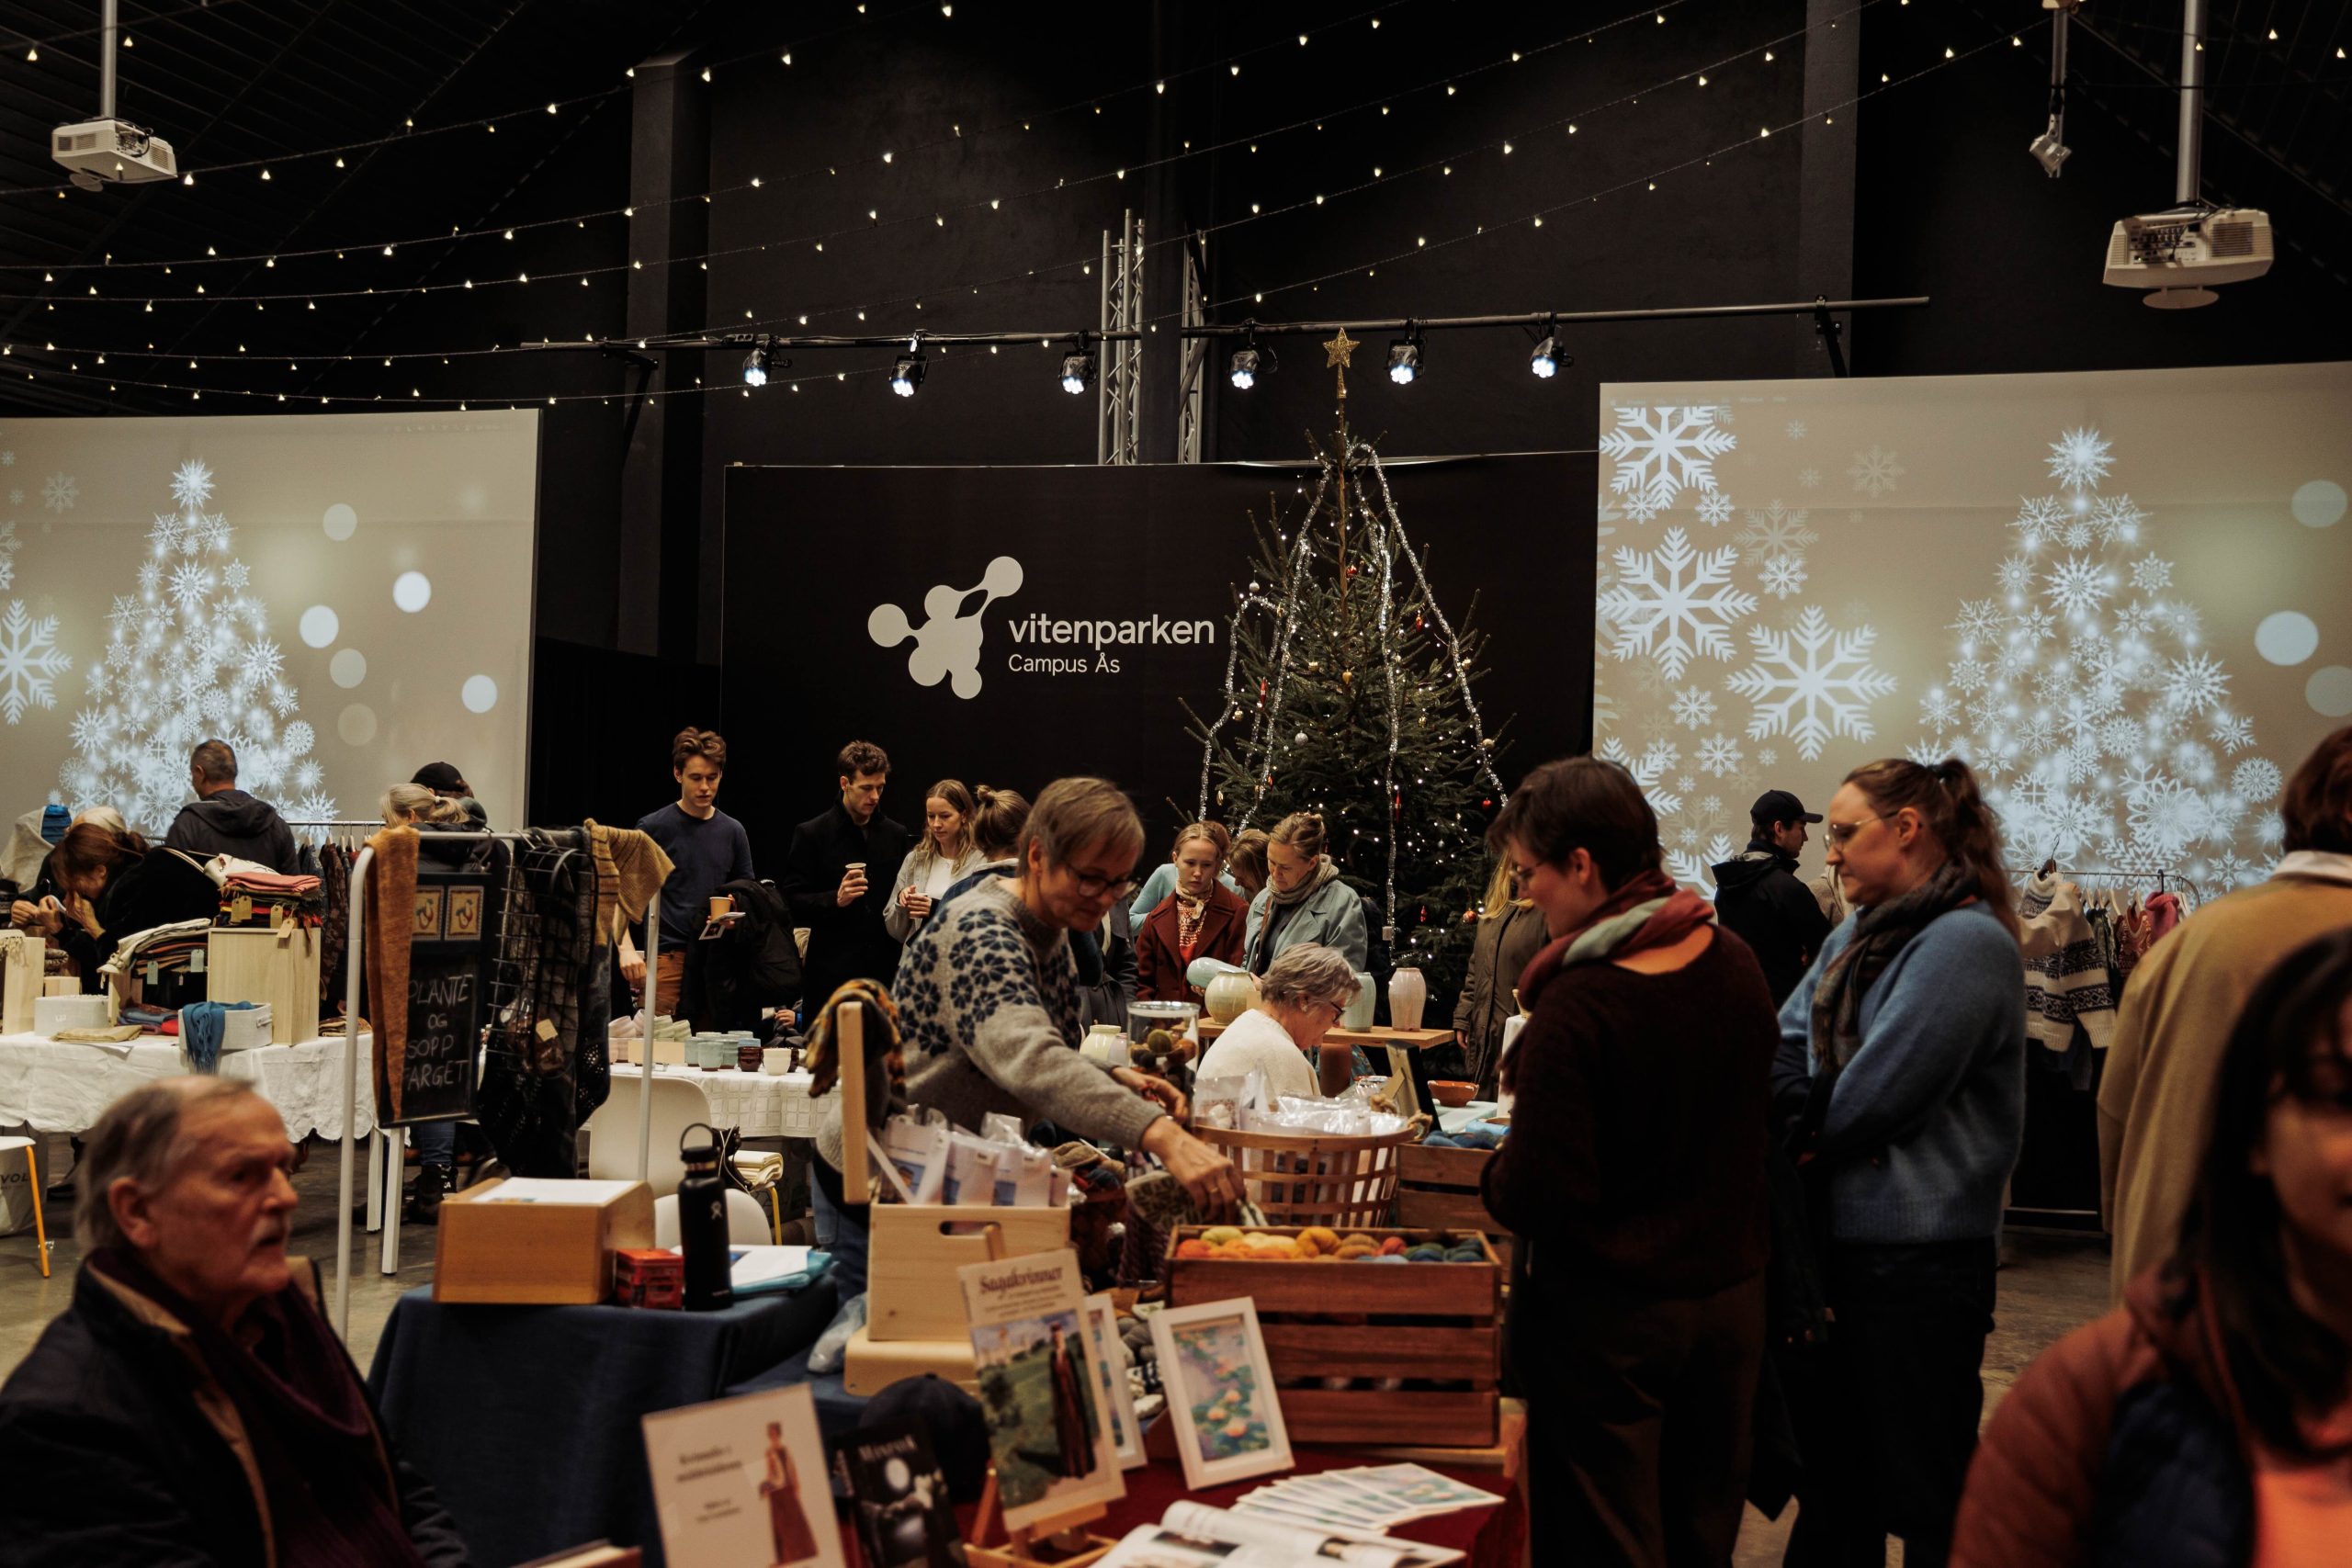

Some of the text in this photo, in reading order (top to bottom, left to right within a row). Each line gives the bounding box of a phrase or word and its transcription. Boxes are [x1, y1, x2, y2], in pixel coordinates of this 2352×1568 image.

[1009, 613, 1215, 650] vitenparken
[1009, 651, 1121, 676] Campus Ås
[427, 1013, 447, 1030] OG
[406, 1034, 454, 1059] SOPP
